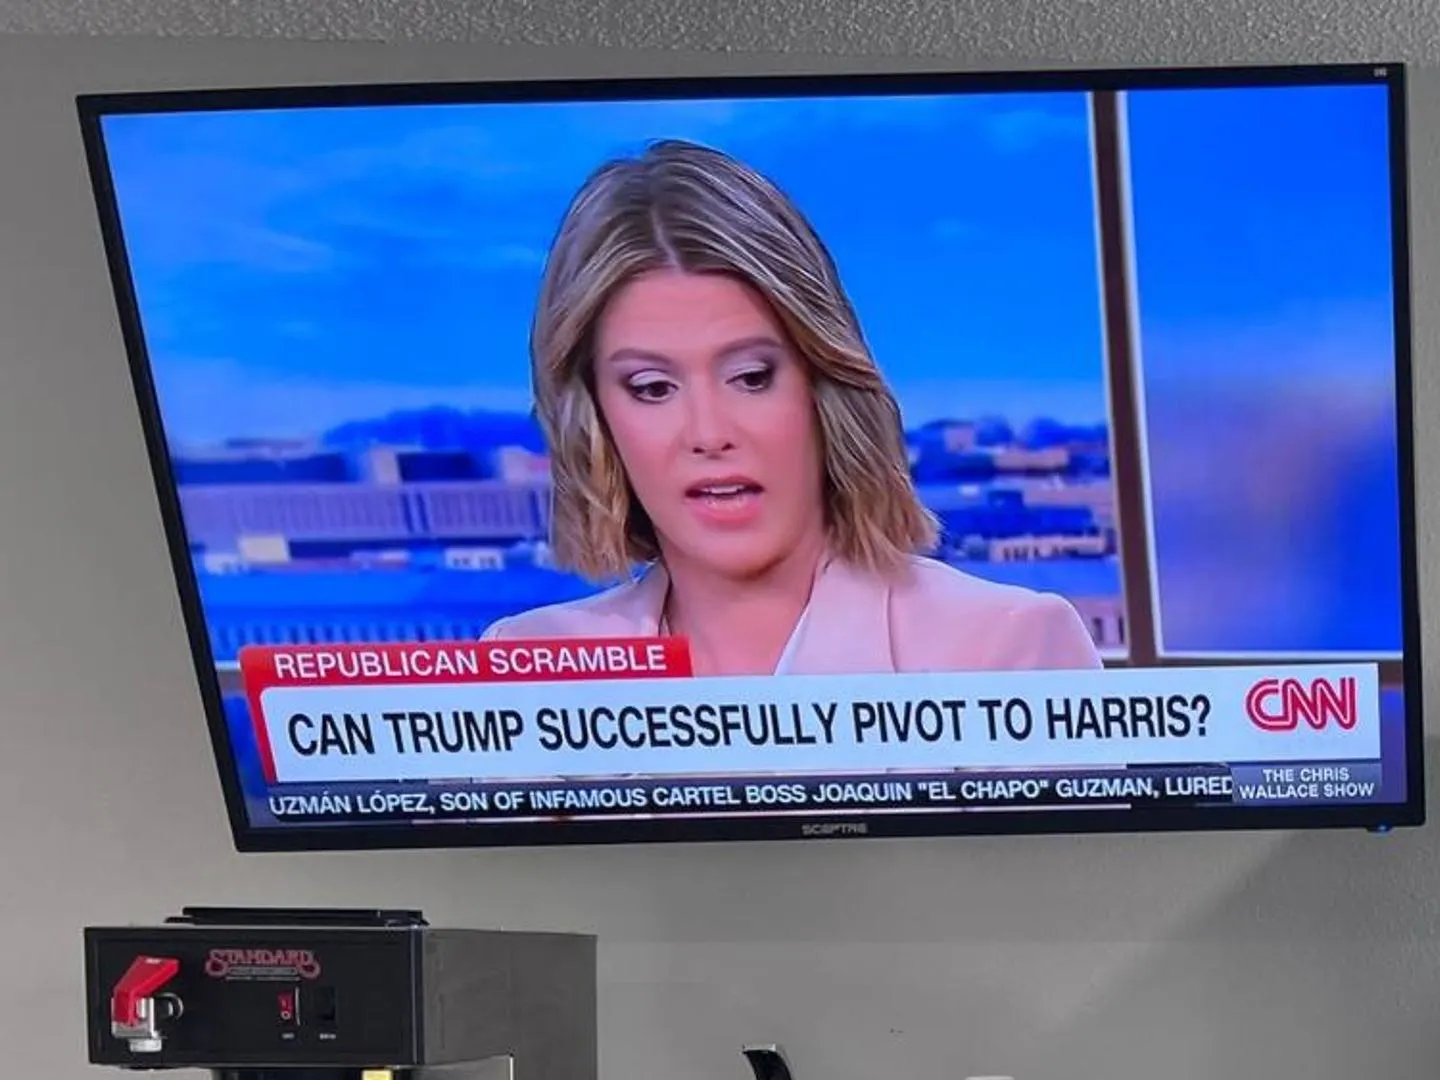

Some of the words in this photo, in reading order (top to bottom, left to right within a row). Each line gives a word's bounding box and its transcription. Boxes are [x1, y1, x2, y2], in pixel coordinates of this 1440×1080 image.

[274, 648, 480, 678] REPUBLICAN
[488, 644, 667, 674] SCRAMBLE
[1246, 677, 1358, 731] CNN
[288, 712, 375, 755] CAN
[383, 709, 524, 753] TRUMP
[537, 702, 838, 751] SUCCESSFULLY
[851, 699, 967, 743] PIVOT
[977, 697, 1032, 741] TO
[1046, 694, 1211, 740] HARRIS?
[1238, 784, 1320, 799] WALLACE
[1323, 783, 1376, 797] SHOW
[1262, 768, 1294, 782] THE
[1299, 767, 1350, 782] CHRIS
[269, 790, 350, 815] UZMÁN
[356, 789, 435, 815] LÓPEZ,
[440, 792, 488, 811] SON
[493, 791, 525, 810] OF
[529, 788, 647, 810] INFAMOUS
[652, 785, 740, 806] CARTEL
[745, 784, 806, 804] BOSS
[812, 782, 912, 802] JOAQUIN
[918, 781, 956, 800] "EL
[961, 779, 1048, 799] CHAPO"
[1055, 778, 1160, 798] GUZMAN,
[1164, 775, 1233, 796] LURED
